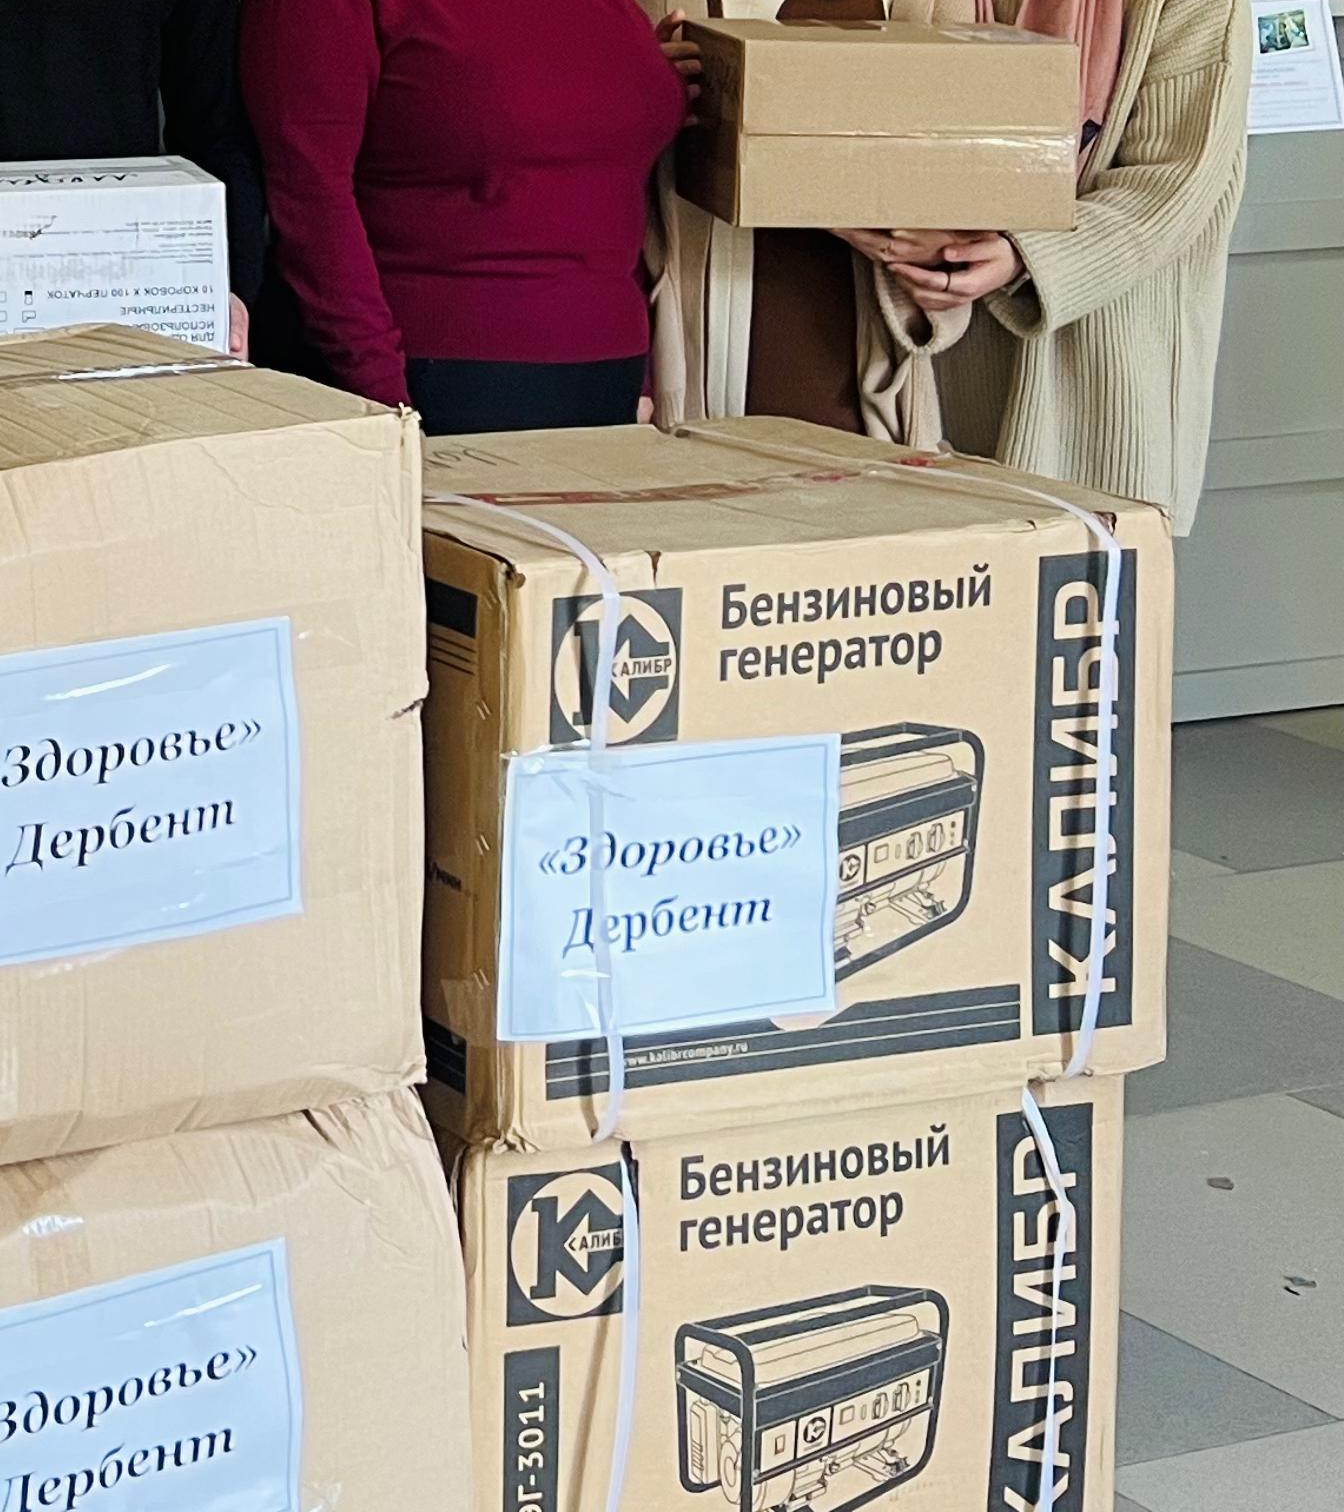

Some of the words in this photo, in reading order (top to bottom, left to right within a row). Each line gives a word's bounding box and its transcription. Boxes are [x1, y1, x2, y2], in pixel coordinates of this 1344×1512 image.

[720, 563, 993, 632] Бензиновый
[719, 624, 944, 685] генератор
[1048, 580, 1120, 1000] КАЛИБР
[5, 796, 237, 876] Дербент
[562, 894, 773, 960] Дербент
[624, 1041, 749, 1068] ww.kalibrcompany.ru
[679, 1125, 950, 1200] Бензиновый
[679, 1186, 904, 1252] генератор
